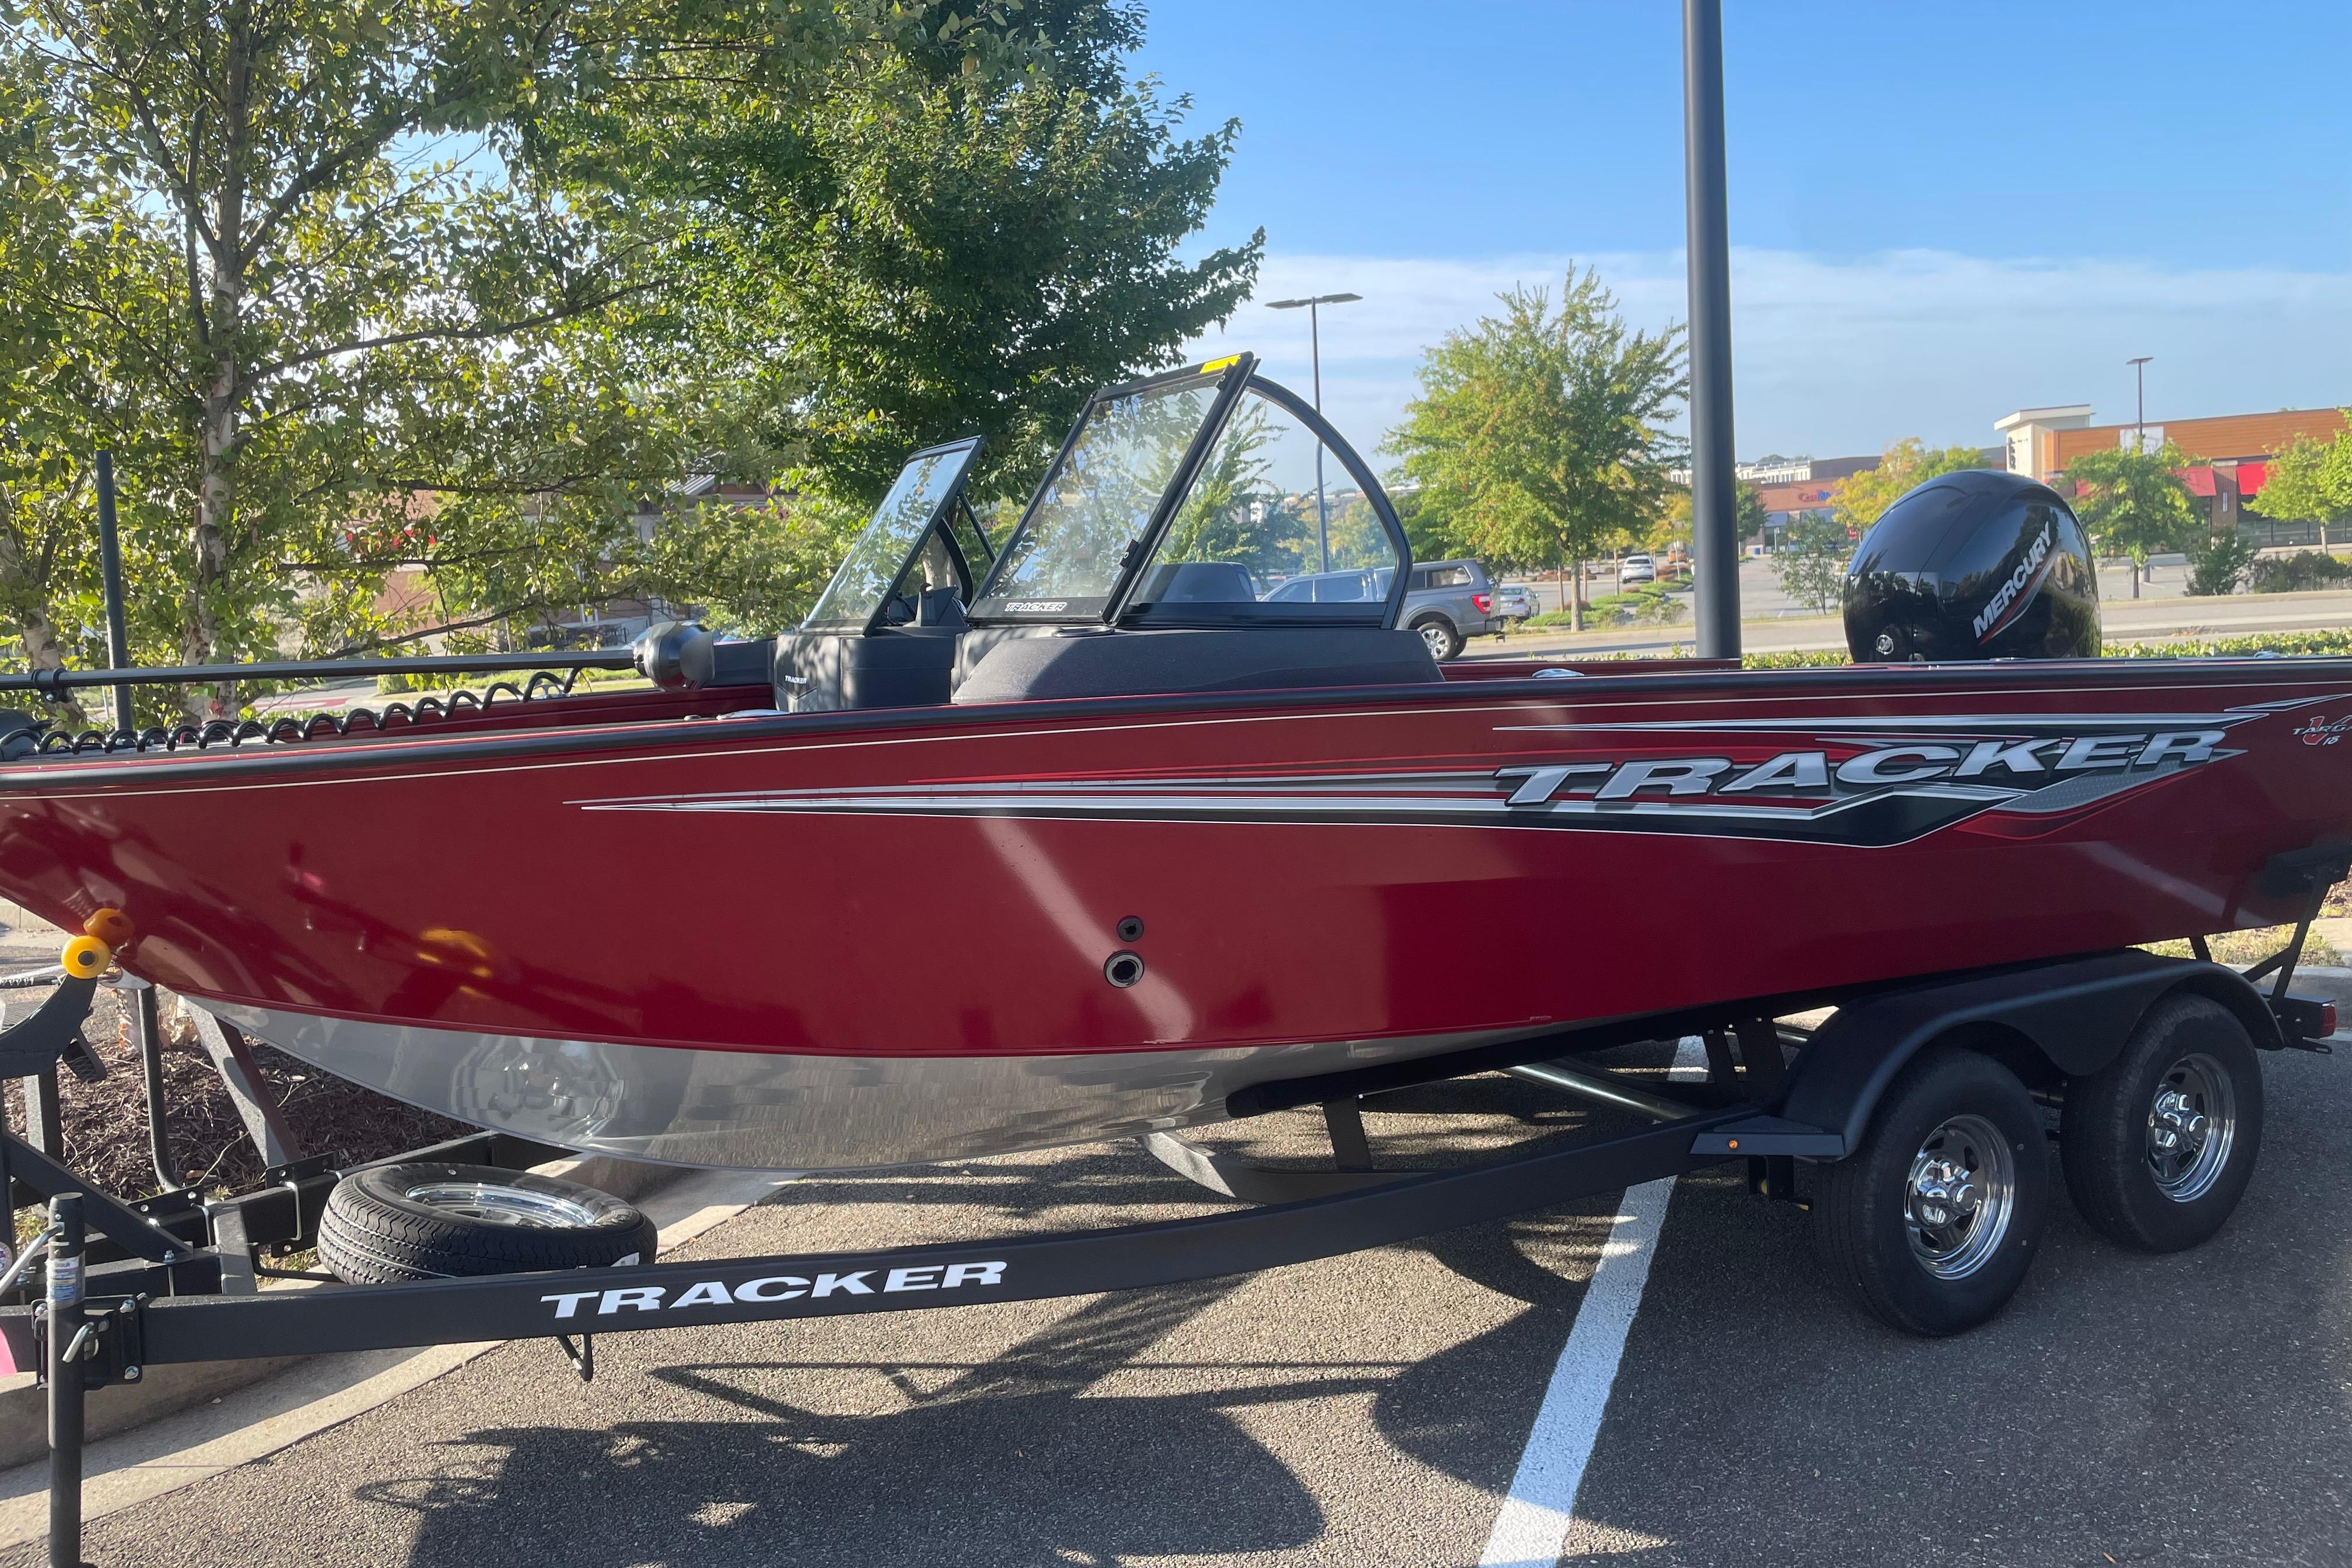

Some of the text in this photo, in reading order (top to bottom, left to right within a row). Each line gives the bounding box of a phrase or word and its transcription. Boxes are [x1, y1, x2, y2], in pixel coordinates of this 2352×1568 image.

[1005, 602, 1067, 611] TRACKER
[1973, 521, 2050, 639] MERCURY
[1493, 729, 2227, 806] TRACKER
[540, 1261, 1008, 1319] TRACKER
